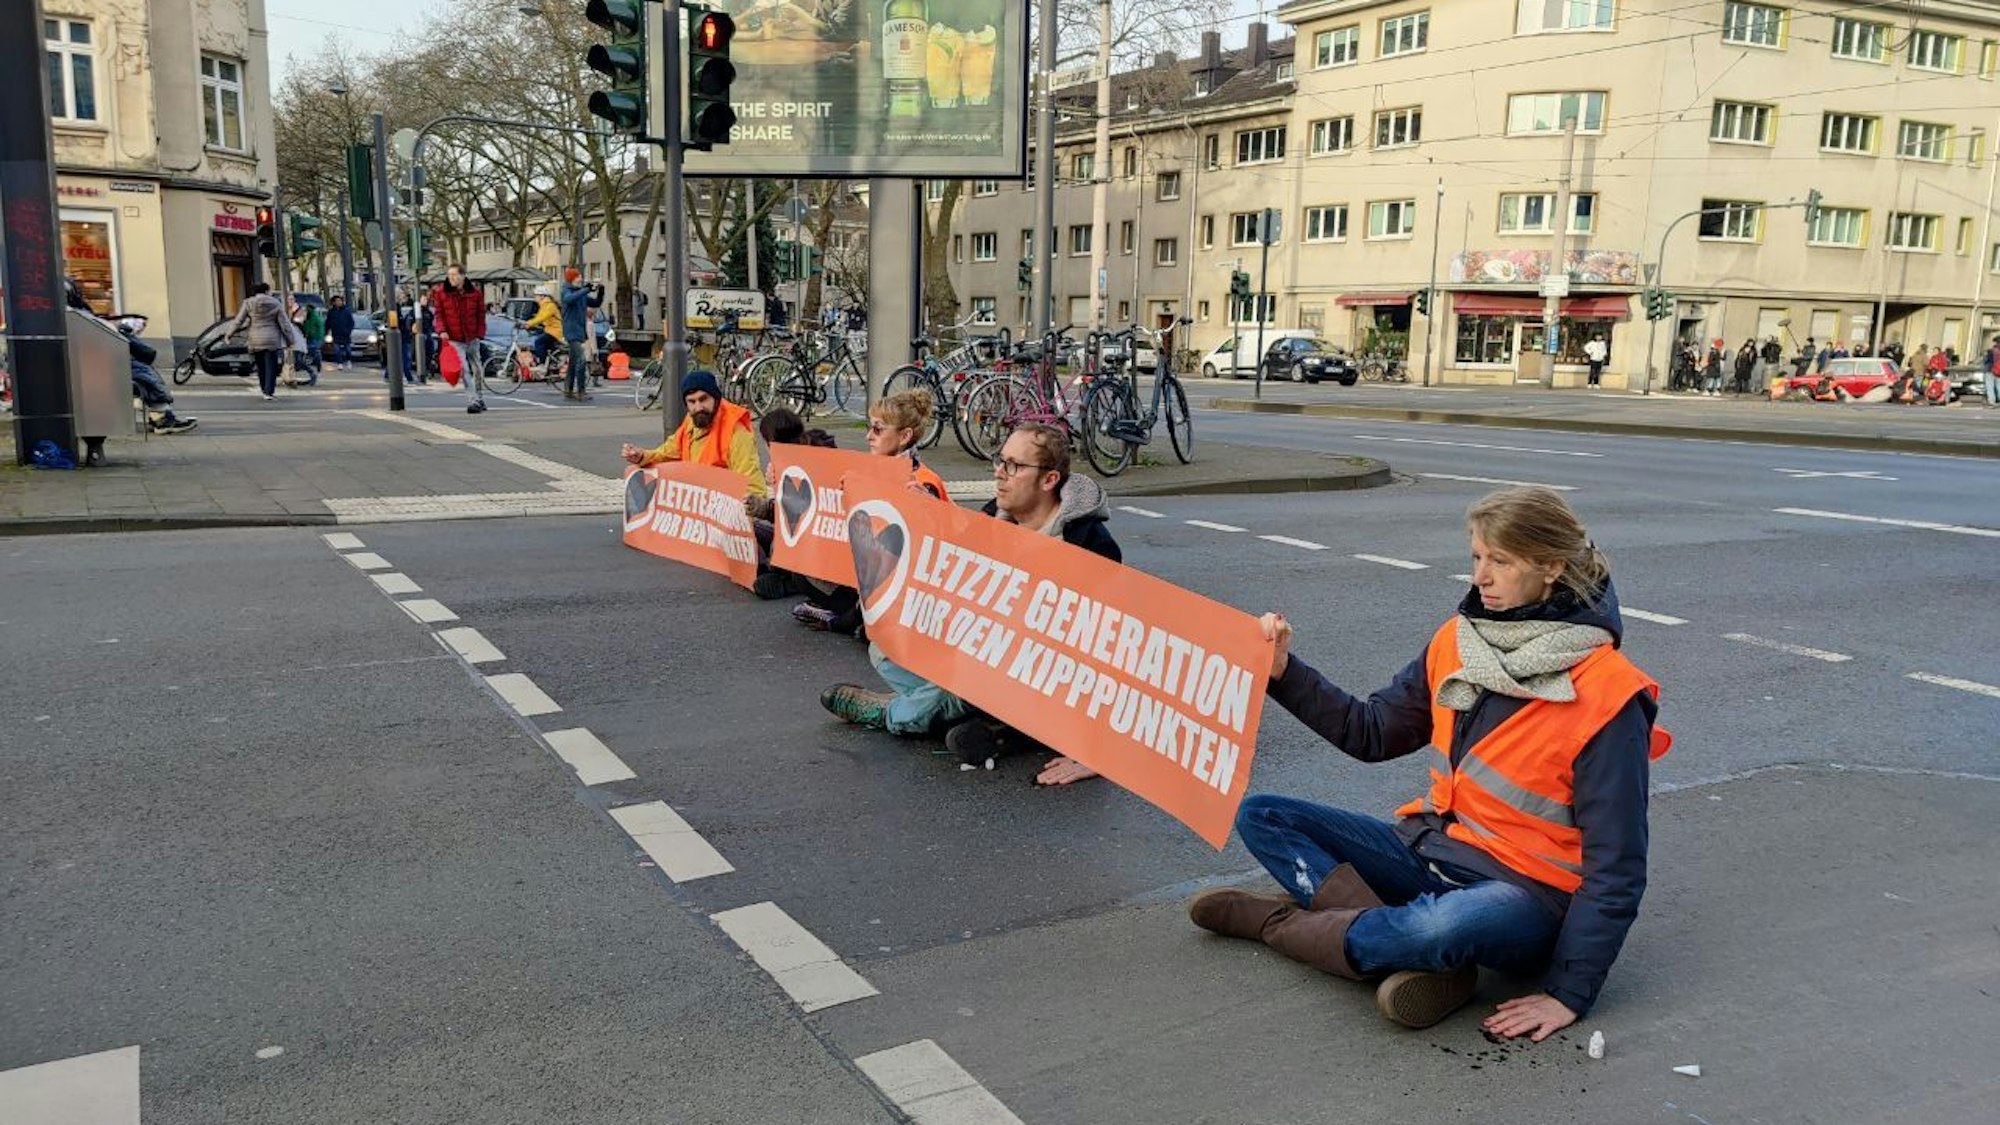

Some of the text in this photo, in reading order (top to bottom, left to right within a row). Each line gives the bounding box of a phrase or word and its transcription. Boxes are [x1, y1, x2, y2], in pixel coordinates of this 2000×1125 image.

[729, 102, 833, 118] THE SPIRIT
[729, 124, 793, 140] SHARE
[657, 479, 709, 517] LETZTE
[818, 486, 846, 515] ART.
[651, 509, 682, 537] VOR
[913, 535, 1253, 734] LETZTE GENERATION
[899, 587, 1239, 796] VOR DEN KIPPPUNKTEN
